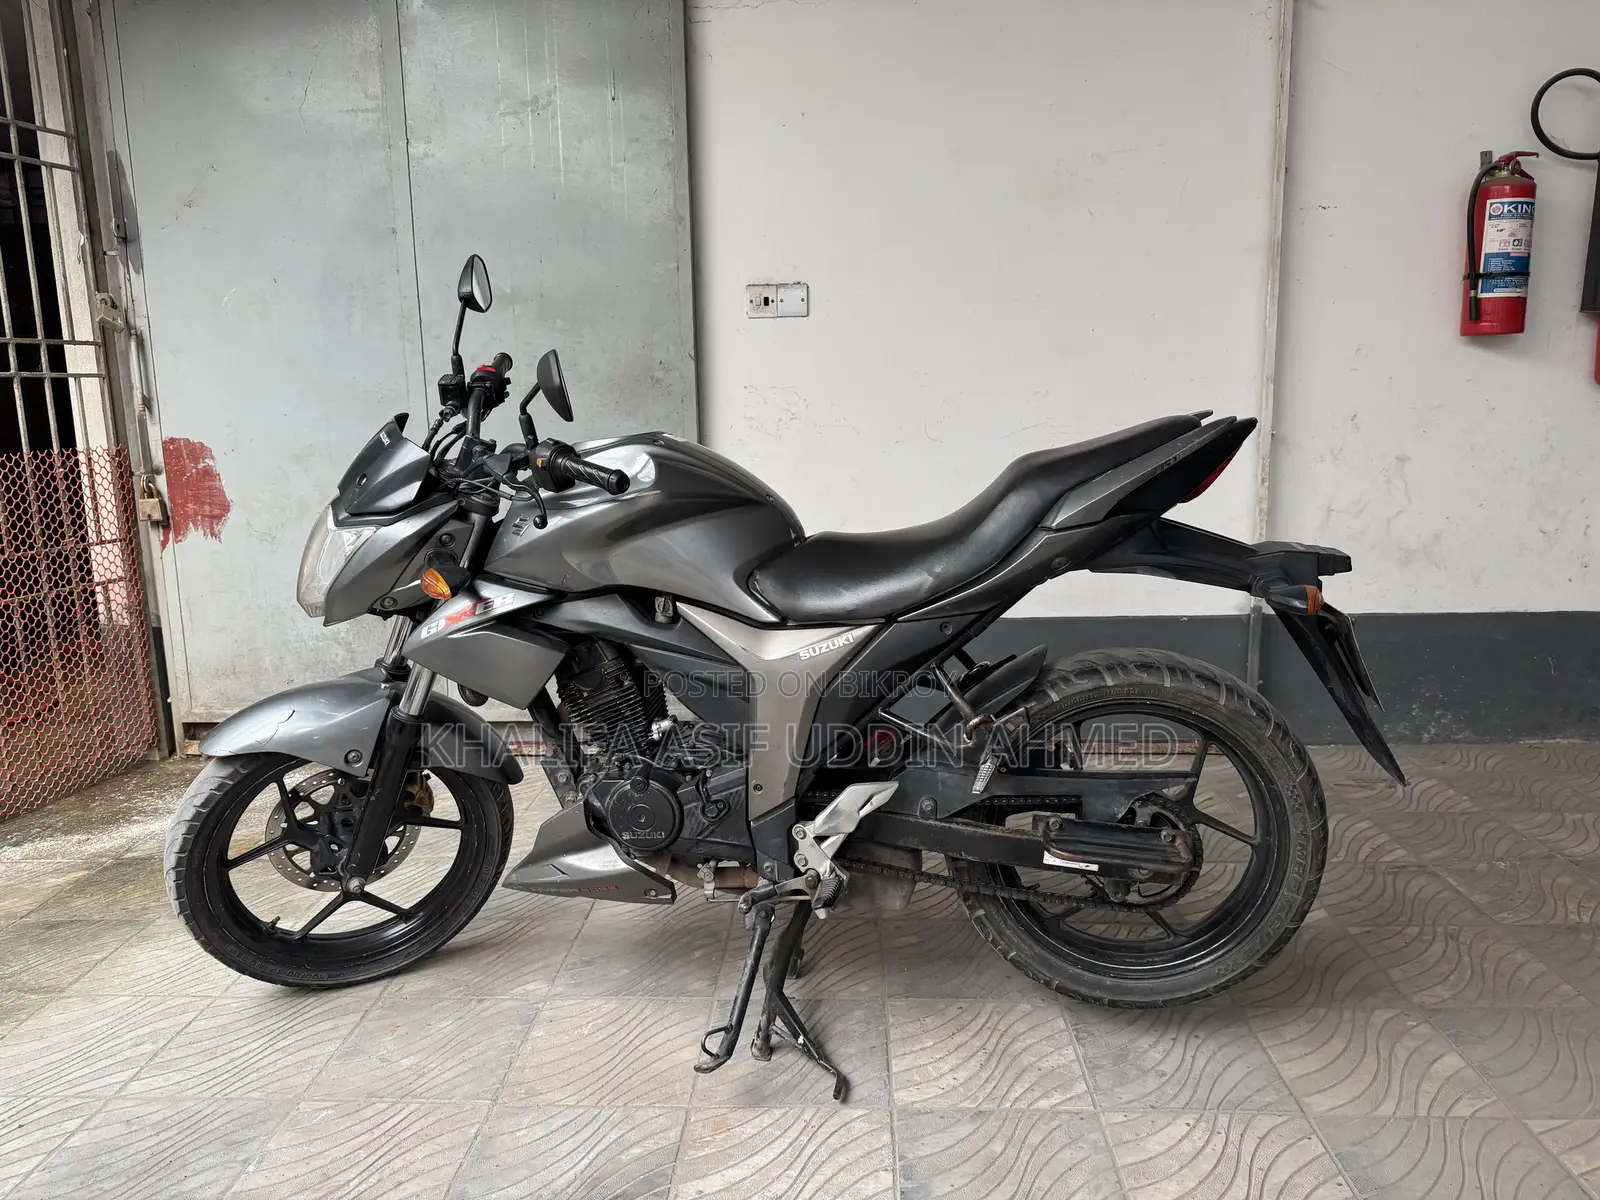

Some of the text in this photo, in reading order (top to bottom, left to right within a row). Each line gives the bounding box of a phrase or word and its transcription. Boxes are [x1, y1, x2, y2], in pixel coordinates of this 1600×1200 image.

[420, 592, 516, 640] GIXXER
[799, 633, 854, 661] SUZUKI
[621, 830, 666, 840] SUZUKI
